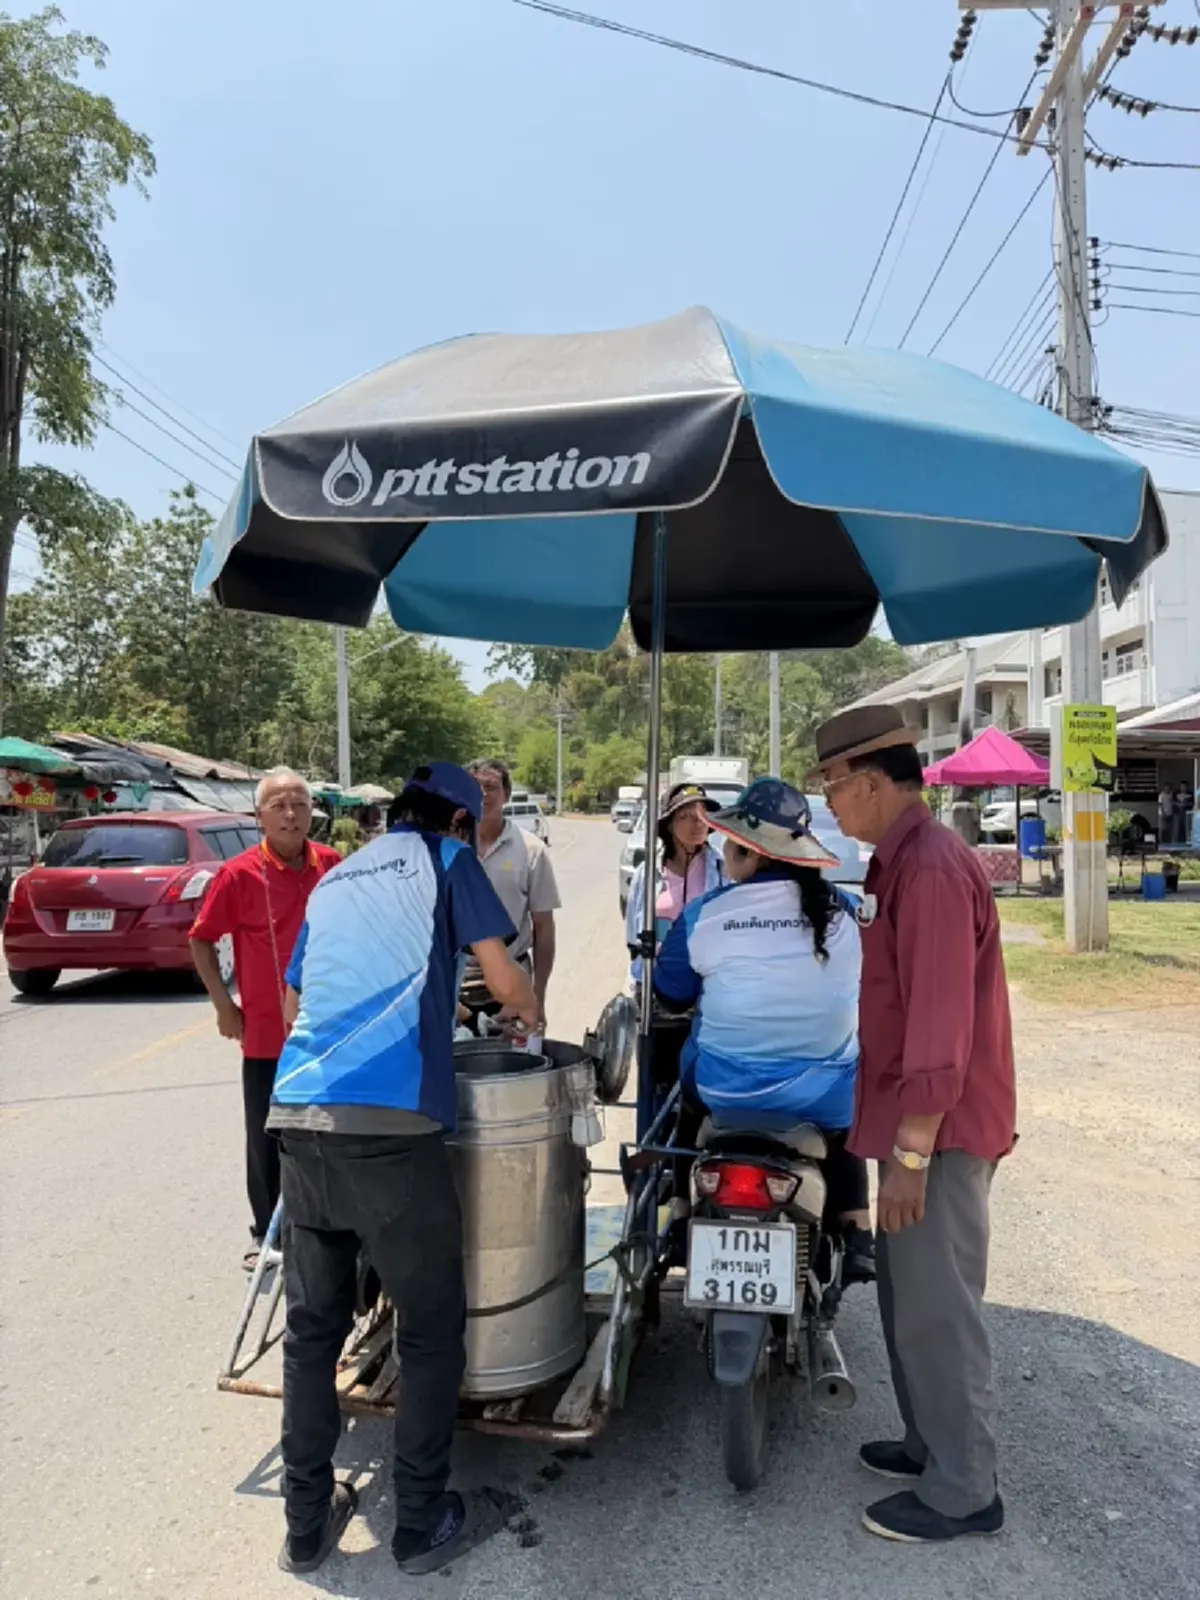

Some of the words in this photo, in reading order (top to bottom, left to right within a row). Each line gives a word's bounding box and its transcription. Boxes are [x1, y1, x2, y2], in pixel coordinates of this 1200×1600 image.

[372, 448, 651, 506] pttstation
[718, 1229, 770, 1253] 1กม
[711, 1258, 770, 1278] สุพรรณบุรี
[704, 1278, 778, 1305] 3169
